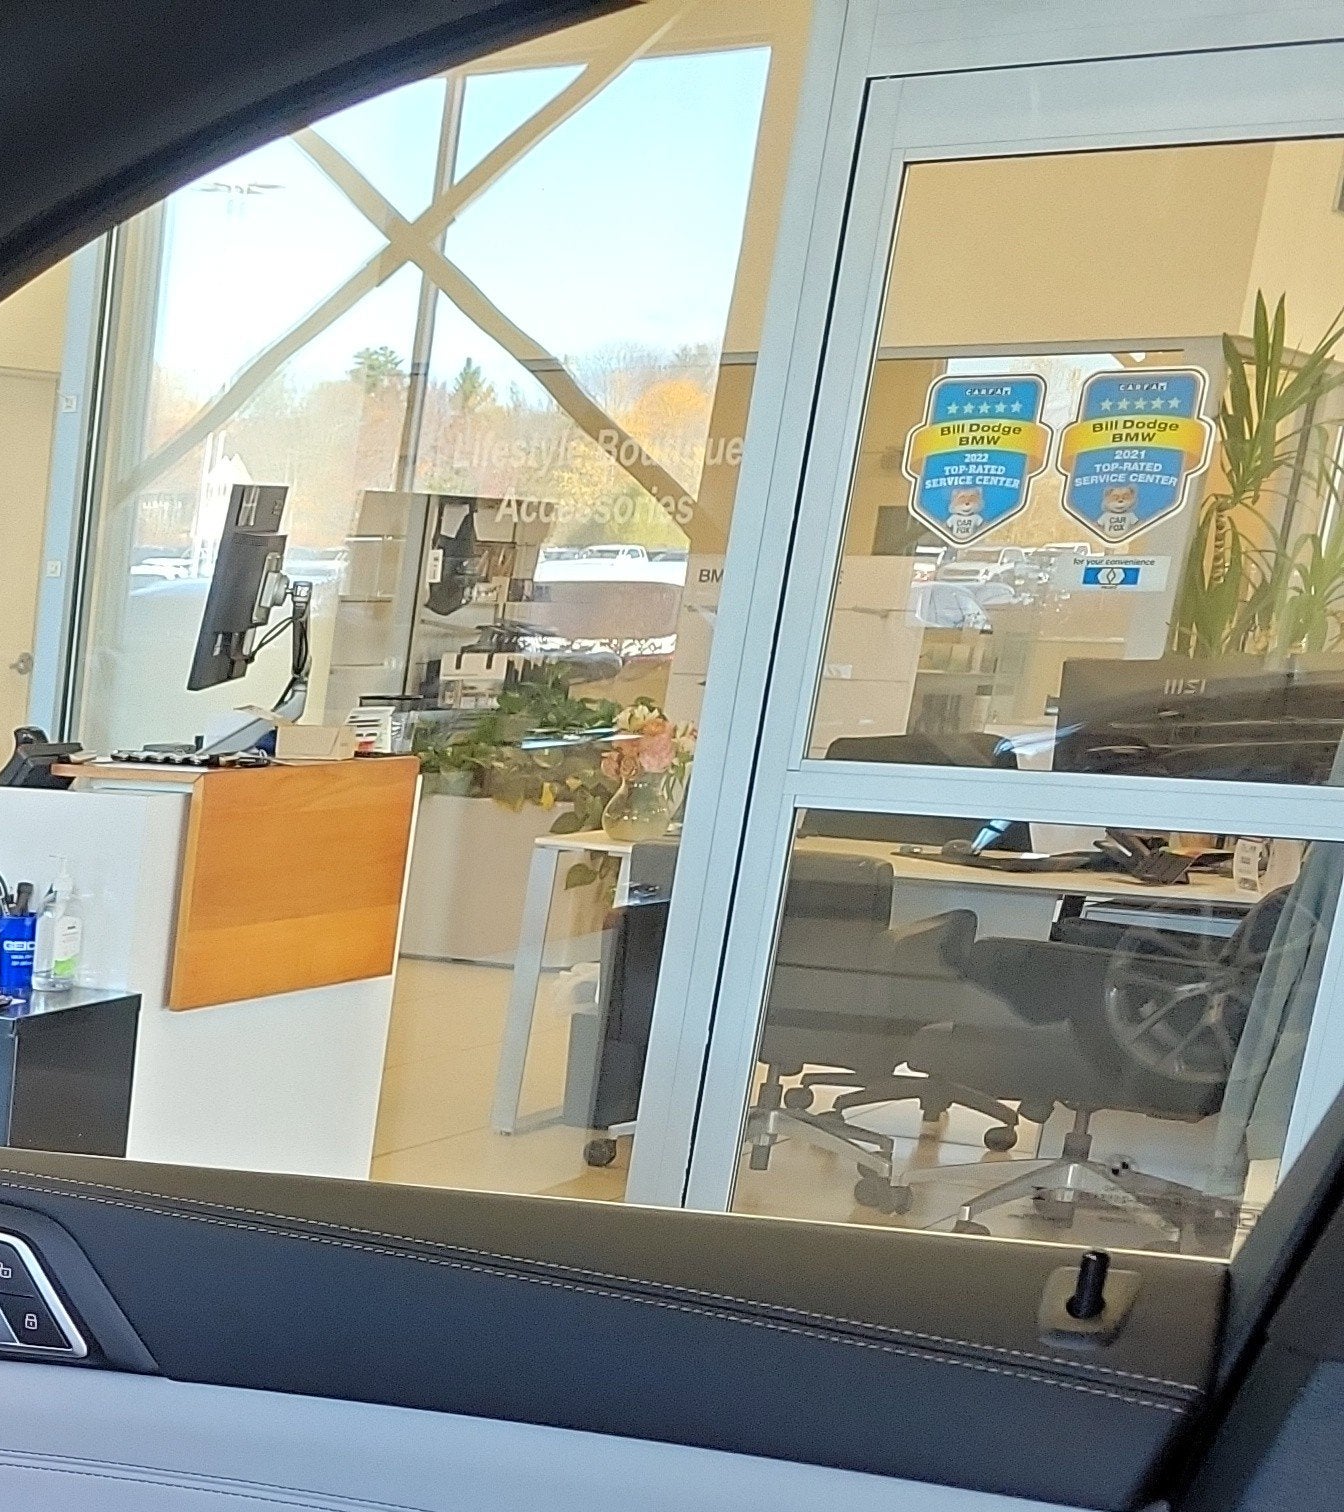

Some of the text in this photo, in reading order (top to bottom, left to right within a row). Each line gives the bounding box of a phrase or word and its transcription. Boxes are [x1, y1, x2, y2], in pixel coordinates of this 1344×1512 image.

[940, 423, 1022, 436] Bill Dodge
[1092, 419, 1180, 433] Bill Dodge
[959, 436, 1001, 446] BMW
[1111, 432, 1157, 443] BMW
[964, 453, 989, 463] 2022
[1114, 450, 1146, 460] 2021
[944, 464, 1006, 476] TOP-RATED
[1094, 462, 1163, 473] TOP-RATED
[925, 476, 1020, 489] SERVICE CENTER
[1075, 473, 1178, 487] SERVICE CENTER
[495, 486, 695, 524] Accessories
[699, 568, 724, 582] BM
[3, 940, 35, 951] GEIC
